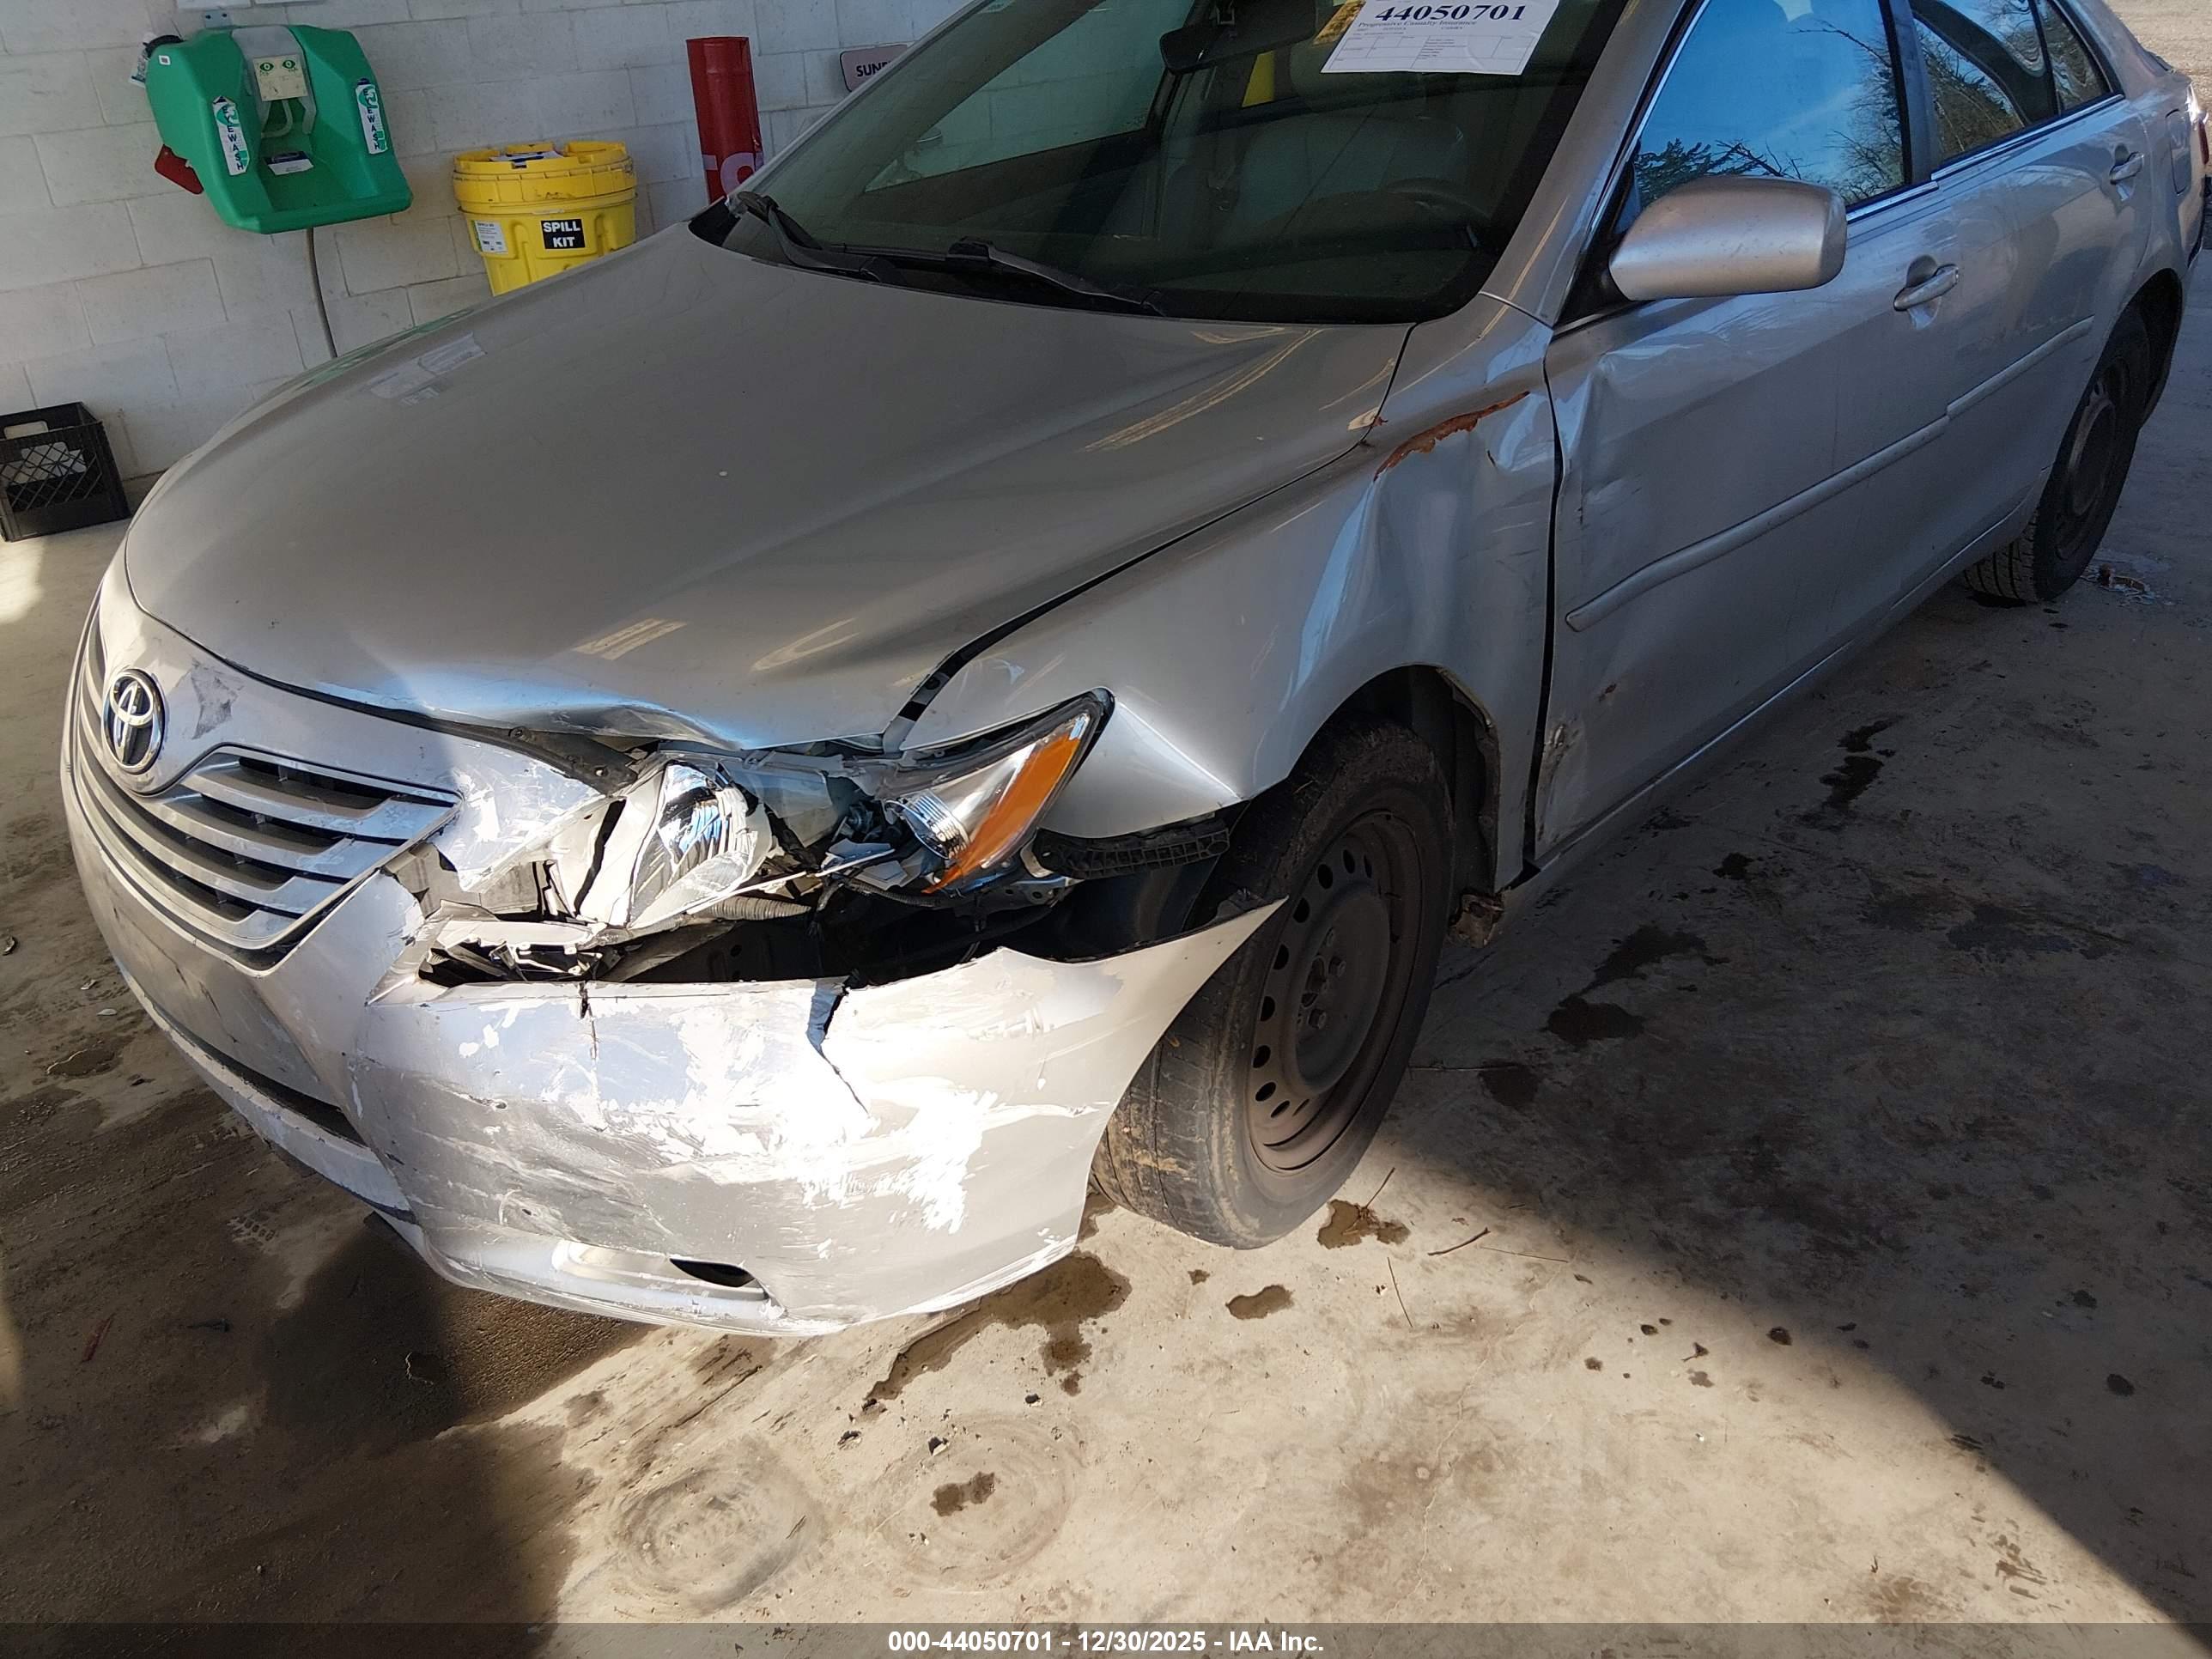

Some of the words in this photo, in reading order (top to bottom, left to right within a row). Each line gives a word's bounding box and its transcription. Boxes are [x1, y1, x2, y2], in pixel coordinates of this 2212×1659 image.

[1375, 4, 1526, 21] 44050701
[543, 221, 580, 233] SPILL
[552, 236, 575, 248] KIT
